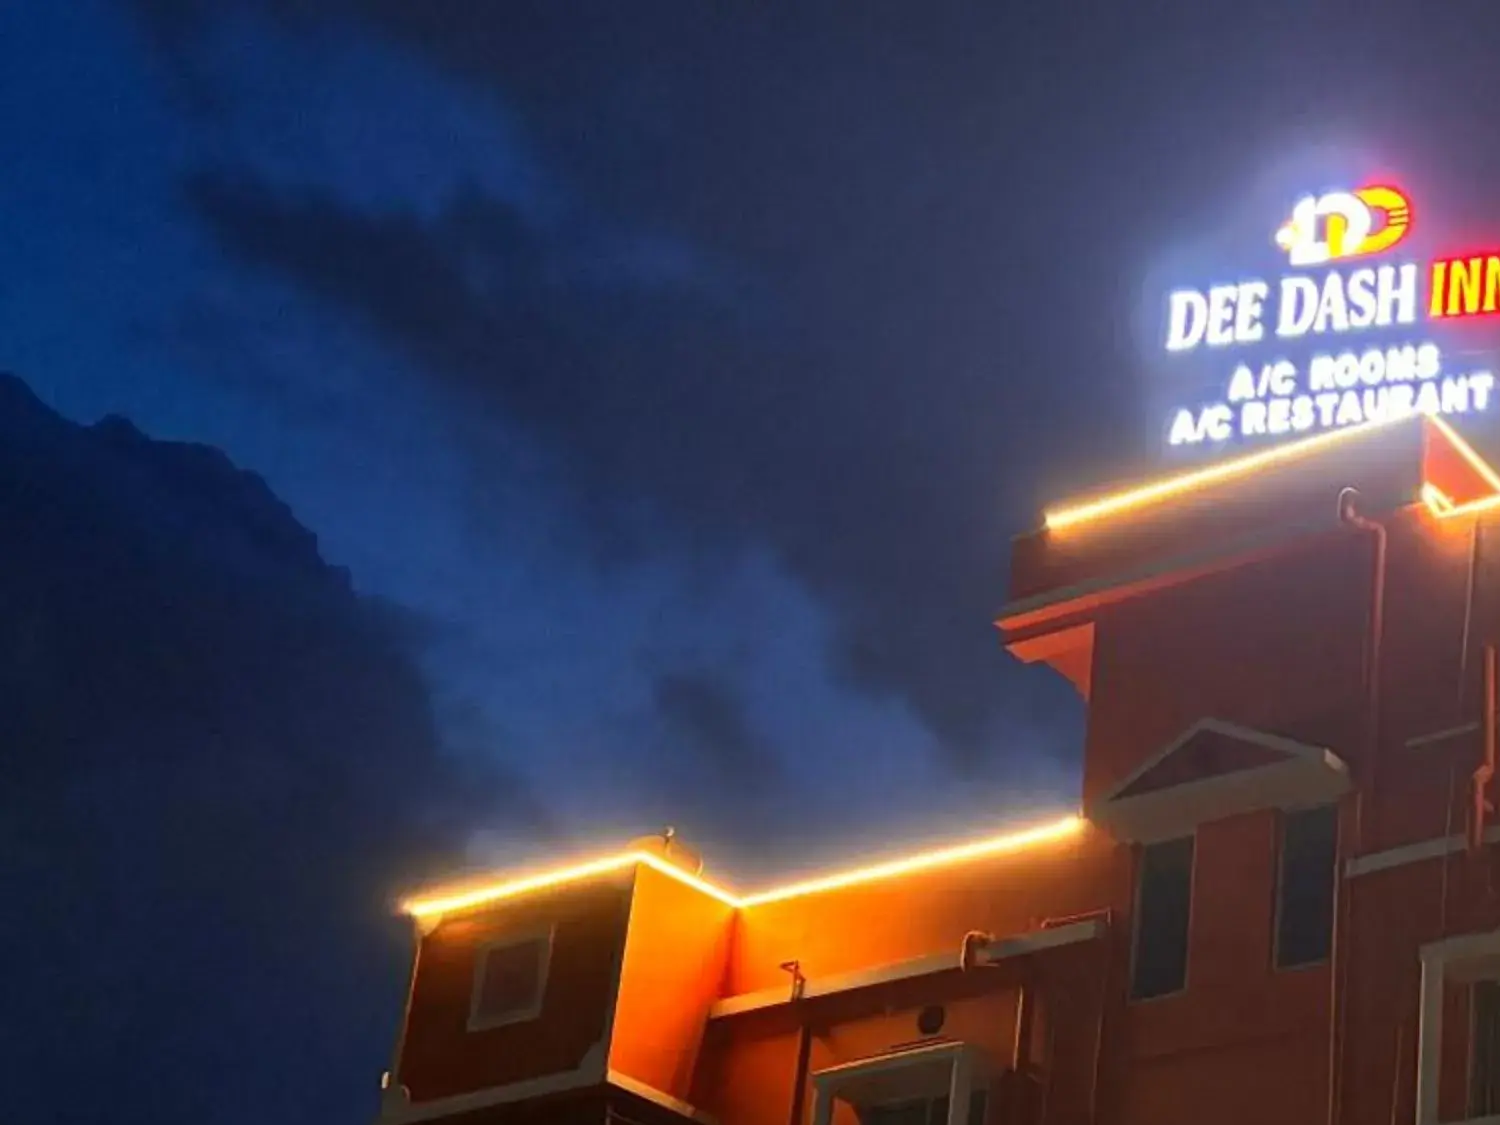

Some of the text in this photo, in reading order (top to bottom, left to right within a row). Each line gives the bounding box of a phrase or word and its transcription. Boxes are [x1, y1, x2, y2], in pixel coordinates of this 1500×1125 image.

[1167, 281, 1268, 351] DEE
[1277, 262, 1417, 337] DASH
[1228, 344, 1440, 401] A/C ROOMS
[1169, 373, 1494, 445] A/C RESTAURANT
